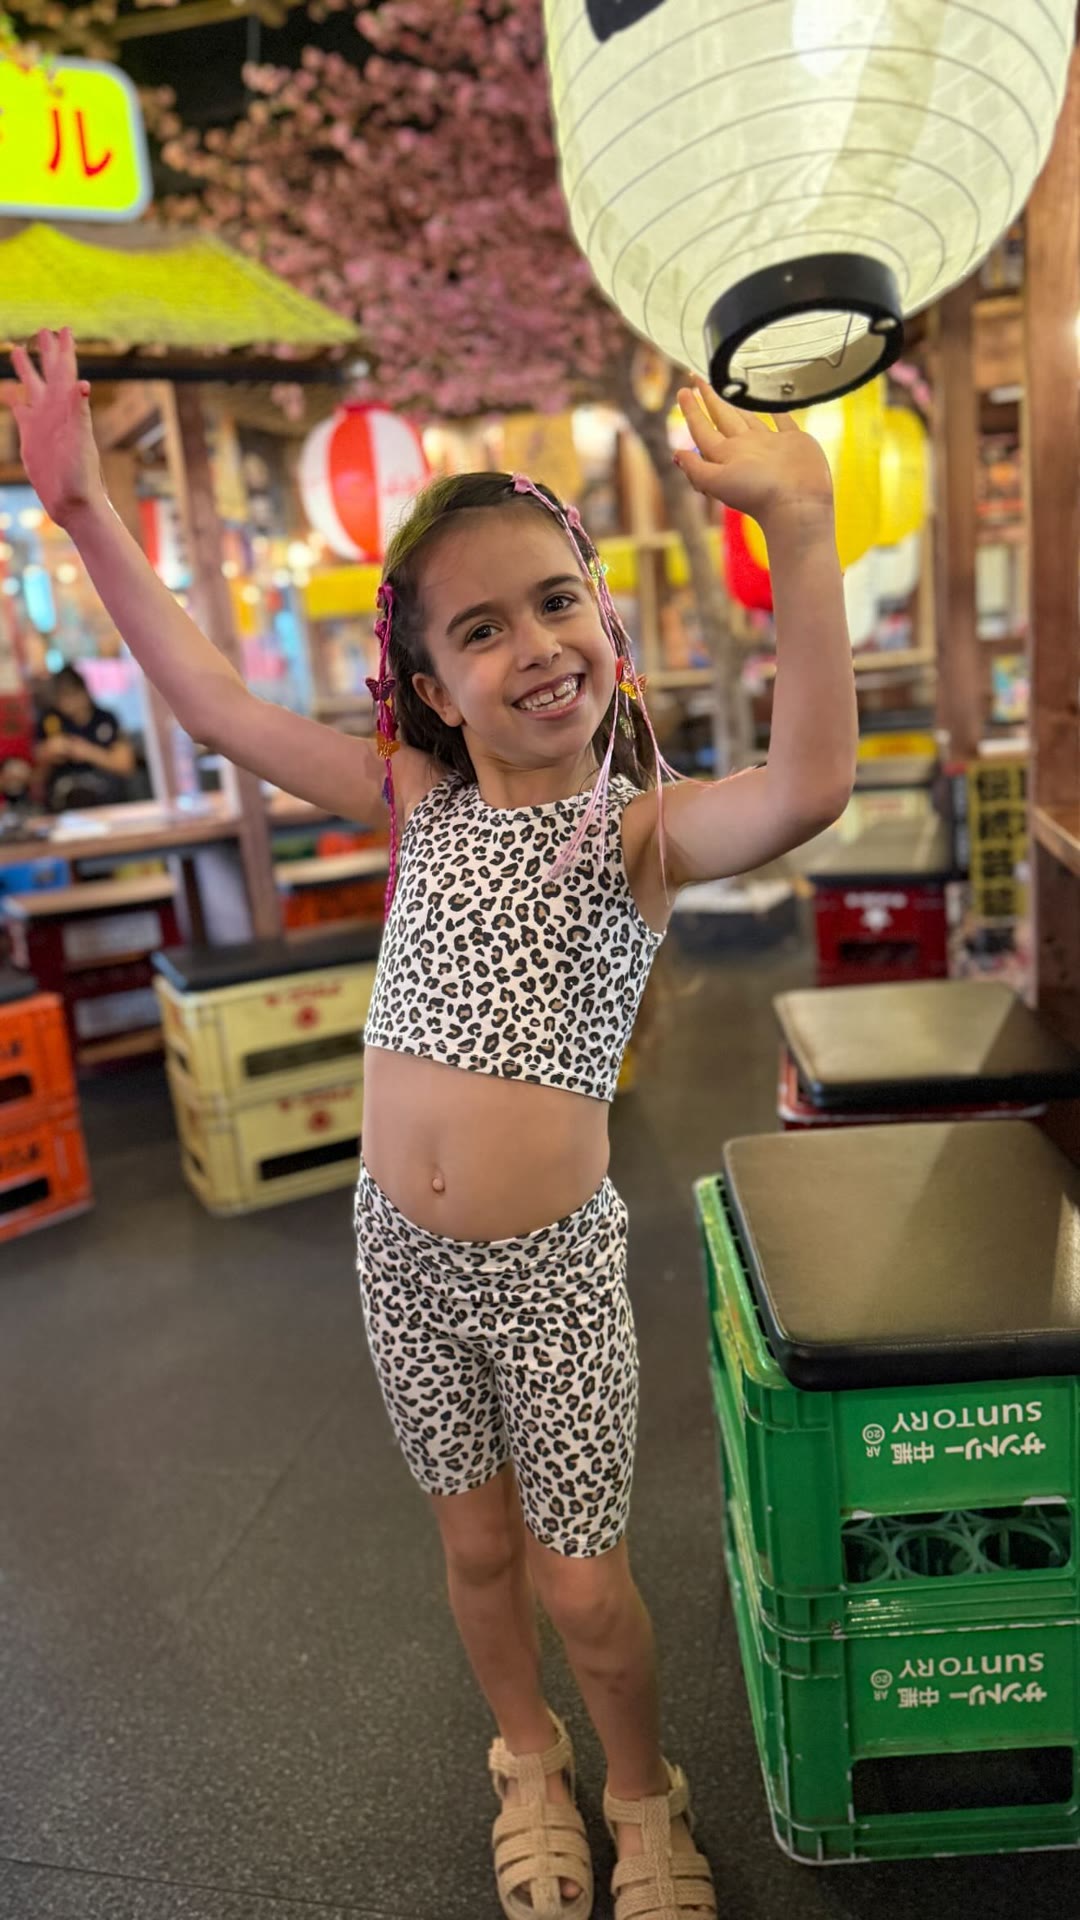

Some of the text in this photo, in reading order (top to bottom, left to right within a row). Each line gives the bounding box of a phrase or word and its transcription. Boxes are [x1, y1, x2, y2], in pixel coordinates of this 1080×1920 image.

[866, 1446, 881, 1458] AR
[944, 1432, 1046, 1460] サントリー
[949, 1682, 1047, 1706] サントリー
